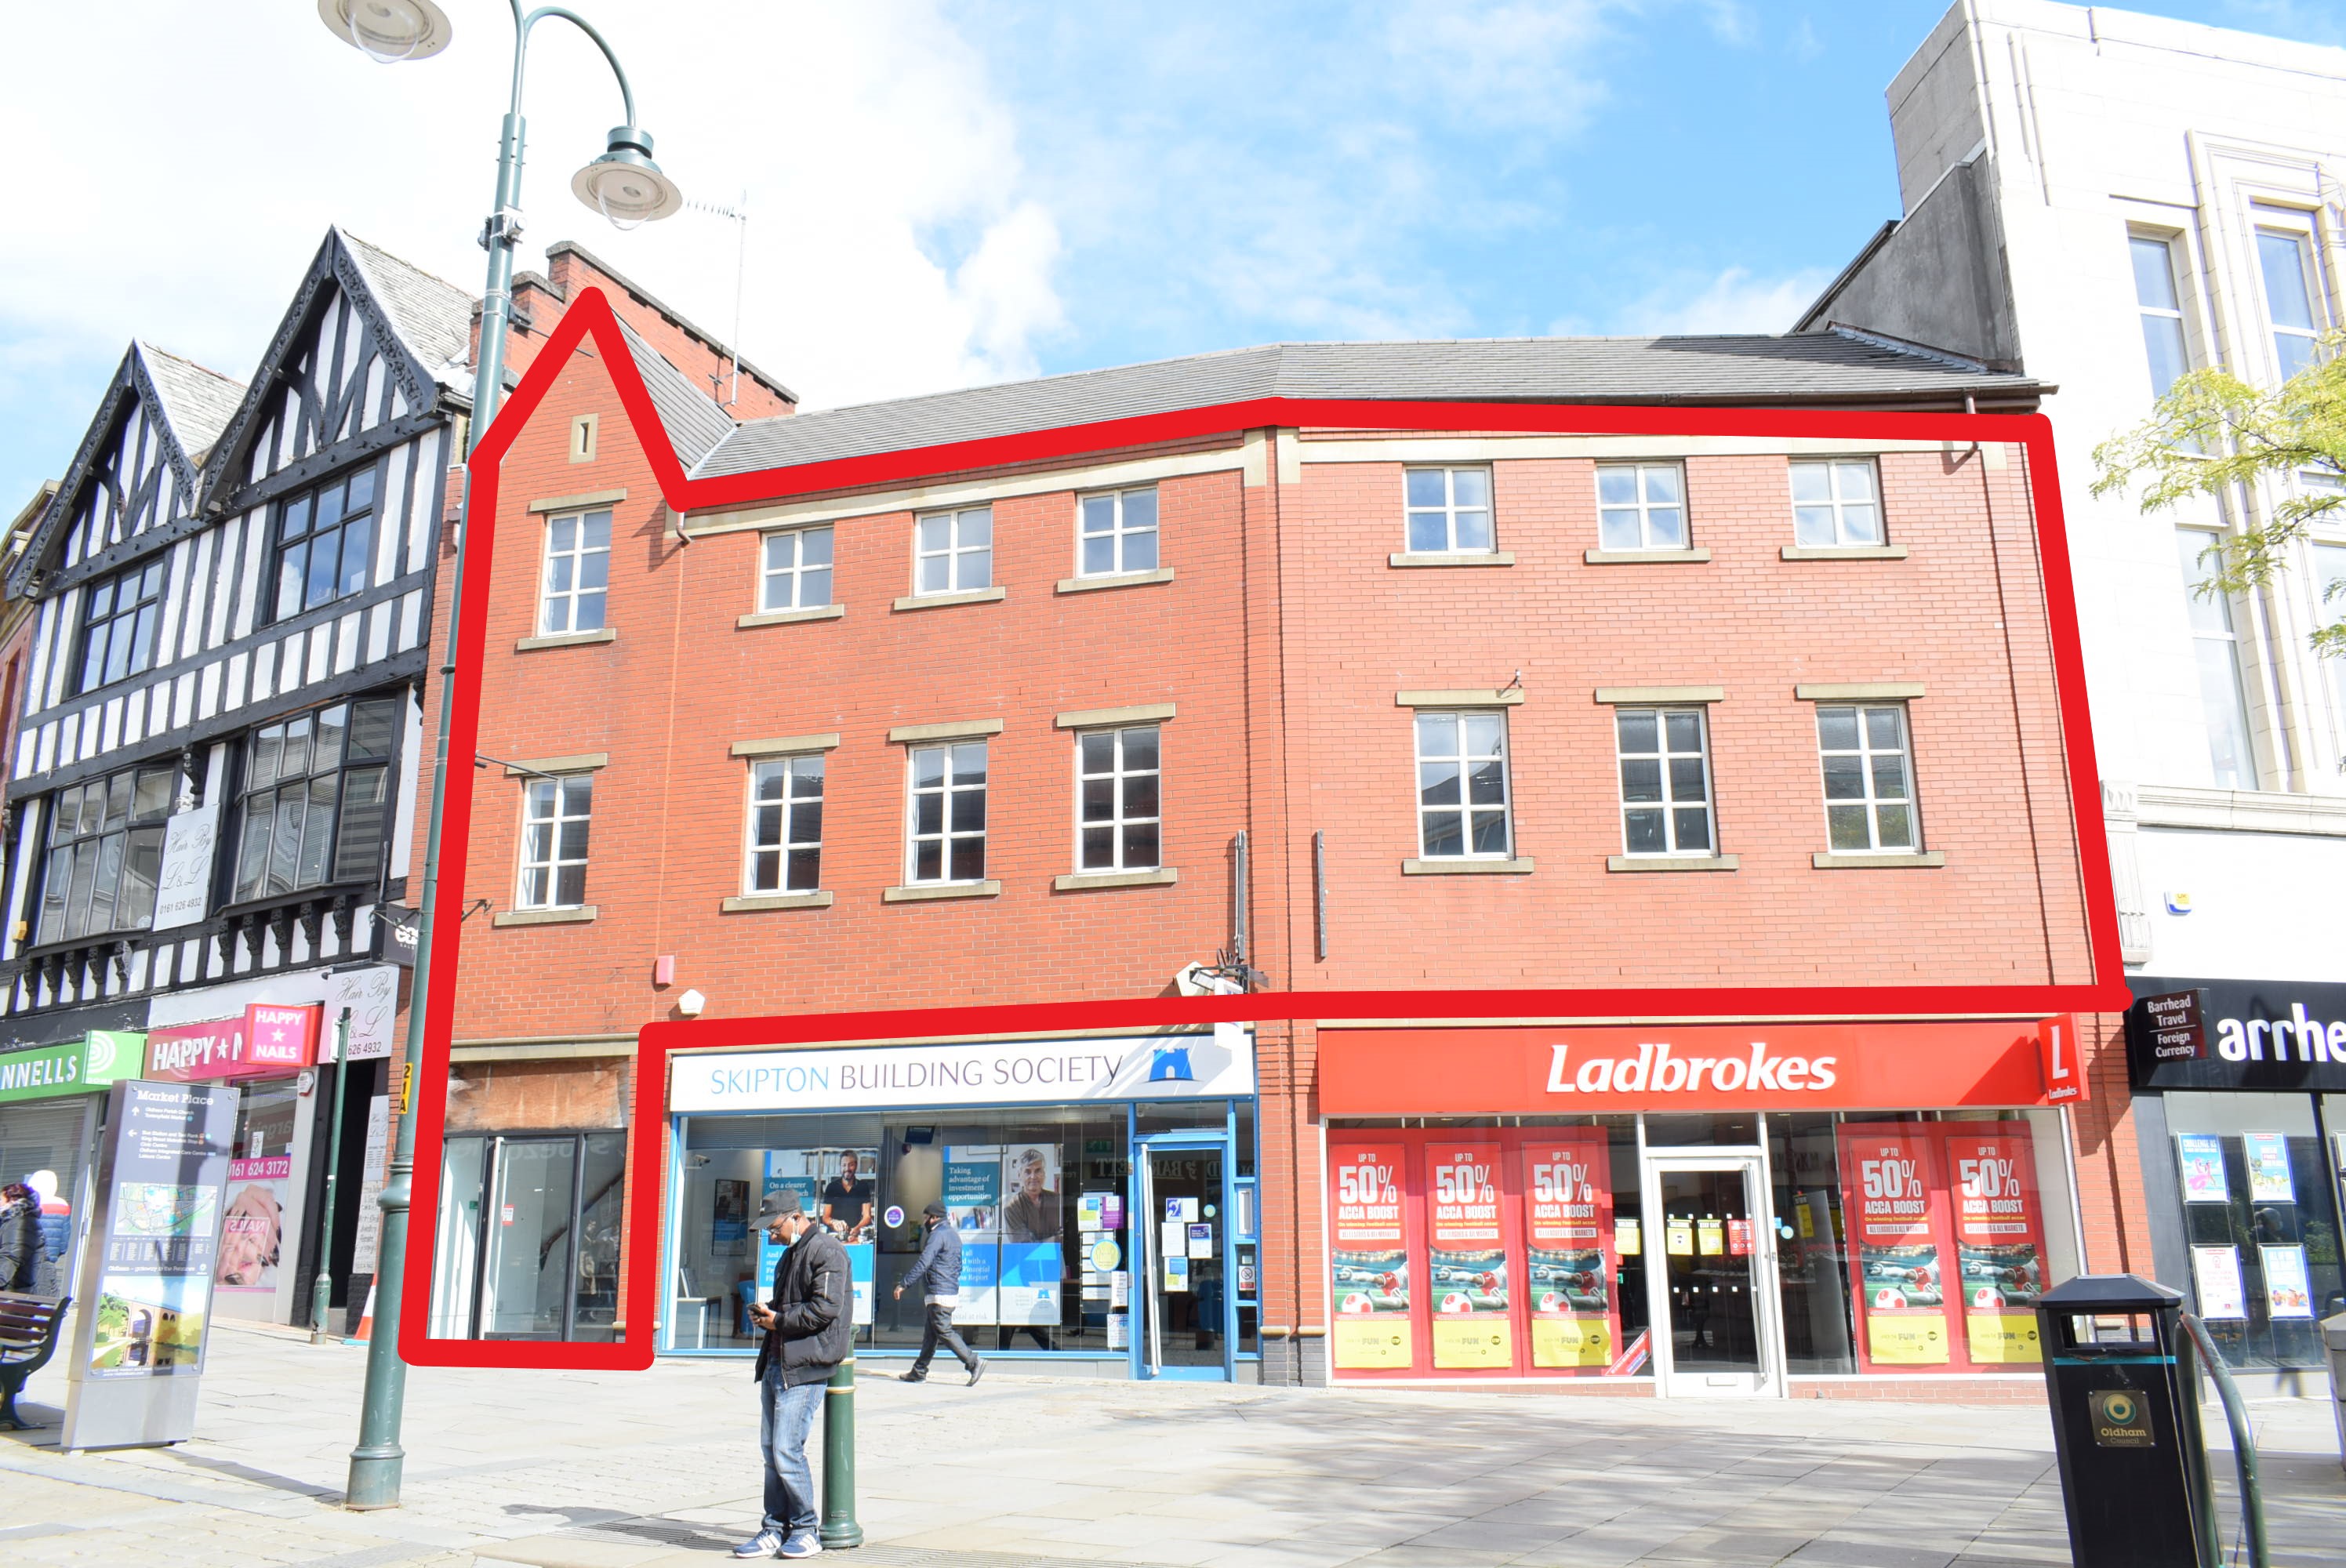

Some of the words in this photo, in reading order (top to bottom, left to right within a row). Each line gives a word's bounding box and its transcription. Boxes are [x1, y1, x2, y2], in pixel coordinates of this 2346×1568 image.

[160, 903, 173, 915] 0161
[175, 902, 187, 911] 626
[187, 897, 202, 908] 4932
[336, 976, 362, 1001] Hair
[368, 971, 391, 1003] By
[2147, 995, 2192, 1014] Barrhead
[256, 1010, 303, 1025] HAPPY
[2156, 1011, 2187, 1027] Travel
[2157, 1032, 2191, 1046] Foreign
[152, 1035, 216, 1071] HAPPY
[256, 1044, 296, 1059] NAILS
[347, 1044, 361, 1054] 626
[362, 1042, 382, 1054] 4932
[2050, 1025, 2068, 1079] L
[2155, 1044, 2195, 1058] Currency
[710, 1067, 830, 1094] SKIPTON
[841, 1060, 983, 1091] BUILDING
[993, 1055, 1123, 1086] SOCIETY
[1545, 1041, 1838, 1094] Ladbrokes
[136, 1090, 180, 1103] Market
[181, 1094, 213, 1105] Place
[2049, 1085, 2078, 1099] Ladbrokes
[1358, 1154, 1366, 1163] UP
[1464, 1153, 1473, 1162] TO
[1552, 1152, 1561, 1161] UP
[1562, 1152, 1570, 1160] TO
[1880, 1148, 1889, 1157] UP
[1890, 1148, 1899, 1156] TO
[1978, 1147, 1987, 1156] UP
[1987, 1147, 1996, 1156] TO
[248, 1162, 264, 1176] 624
[267, 1160, 289, 1174] 3172
[949, 1167, 971, 1175] Taking
[949, 1176, 980, 1185] advantage
[1339, 1166, 1396, 1203] 50%
[1436, 1165, 1494, 1203] 50%
[1534, 1164, 1592, 1202] 50%
[1861, 1160, 1922, 1198] 50%
[1959, 1159, 2020, 1197] 50%
[949, 1193, 992, 1202] opportunities
[1338, 1207, 1365, 1220] ACCA
[1367, 1206, 1399, 1219] BOOST
[1436, 1206, 1463, 1220] ACCA
[1465, 1206, 1496, 1219] BOOST
[1534, 1205, 1560, 1218] ACCA
[1563, 1204, 1595, 1218] BOOST
[1865, 1201, 1891, 1214] ACCA
[1894, 1201, 1925, 1214] BOOST
[1963, 1200, 1988, 1214] ACCA
[1992, 1200, 2023, 1213] BOOST
[2101, 1428, 2146, 1436] Oldham
